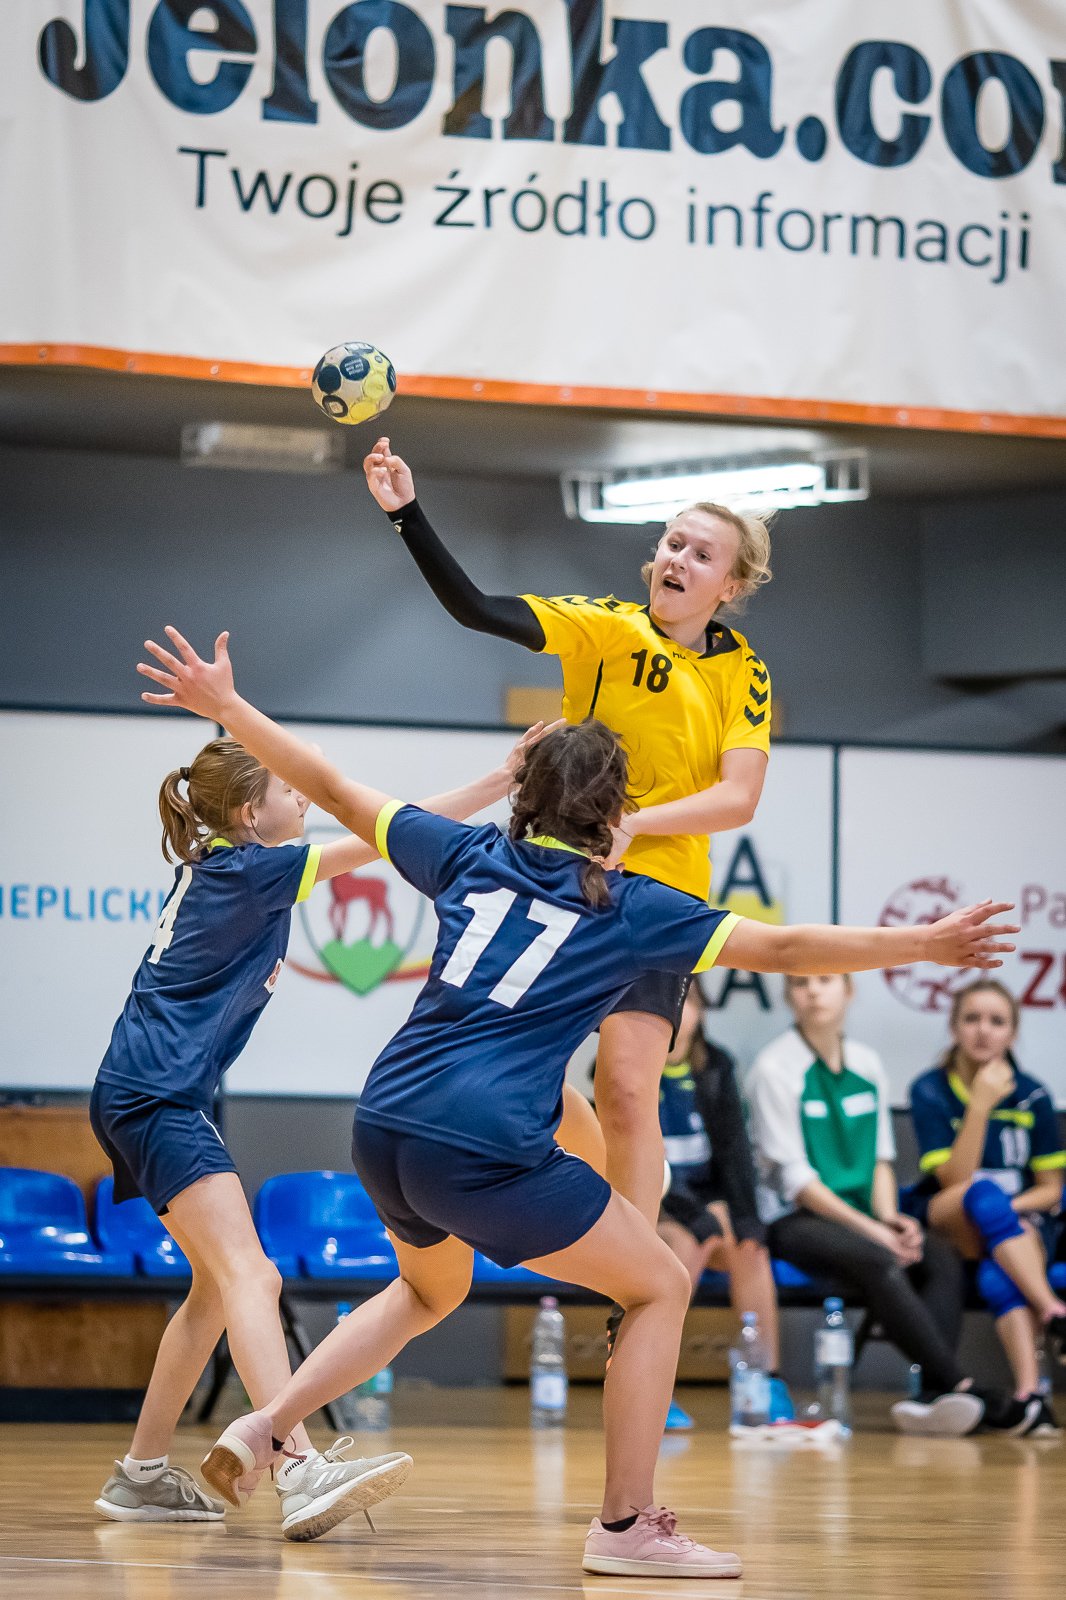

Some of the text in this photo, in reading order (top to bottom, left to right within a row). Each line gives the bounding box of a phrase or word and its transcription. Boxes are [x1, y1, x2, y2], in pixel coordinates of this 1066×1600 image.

[38, 0, 1066, 185] Jelonka.co
[178, 146, 1032, 285] Twoje źródło informacji
[630, 648, 673, 694] 18
[439, 887, 581, 1009] 17
[1020, 951, 1066, 1009] Z
